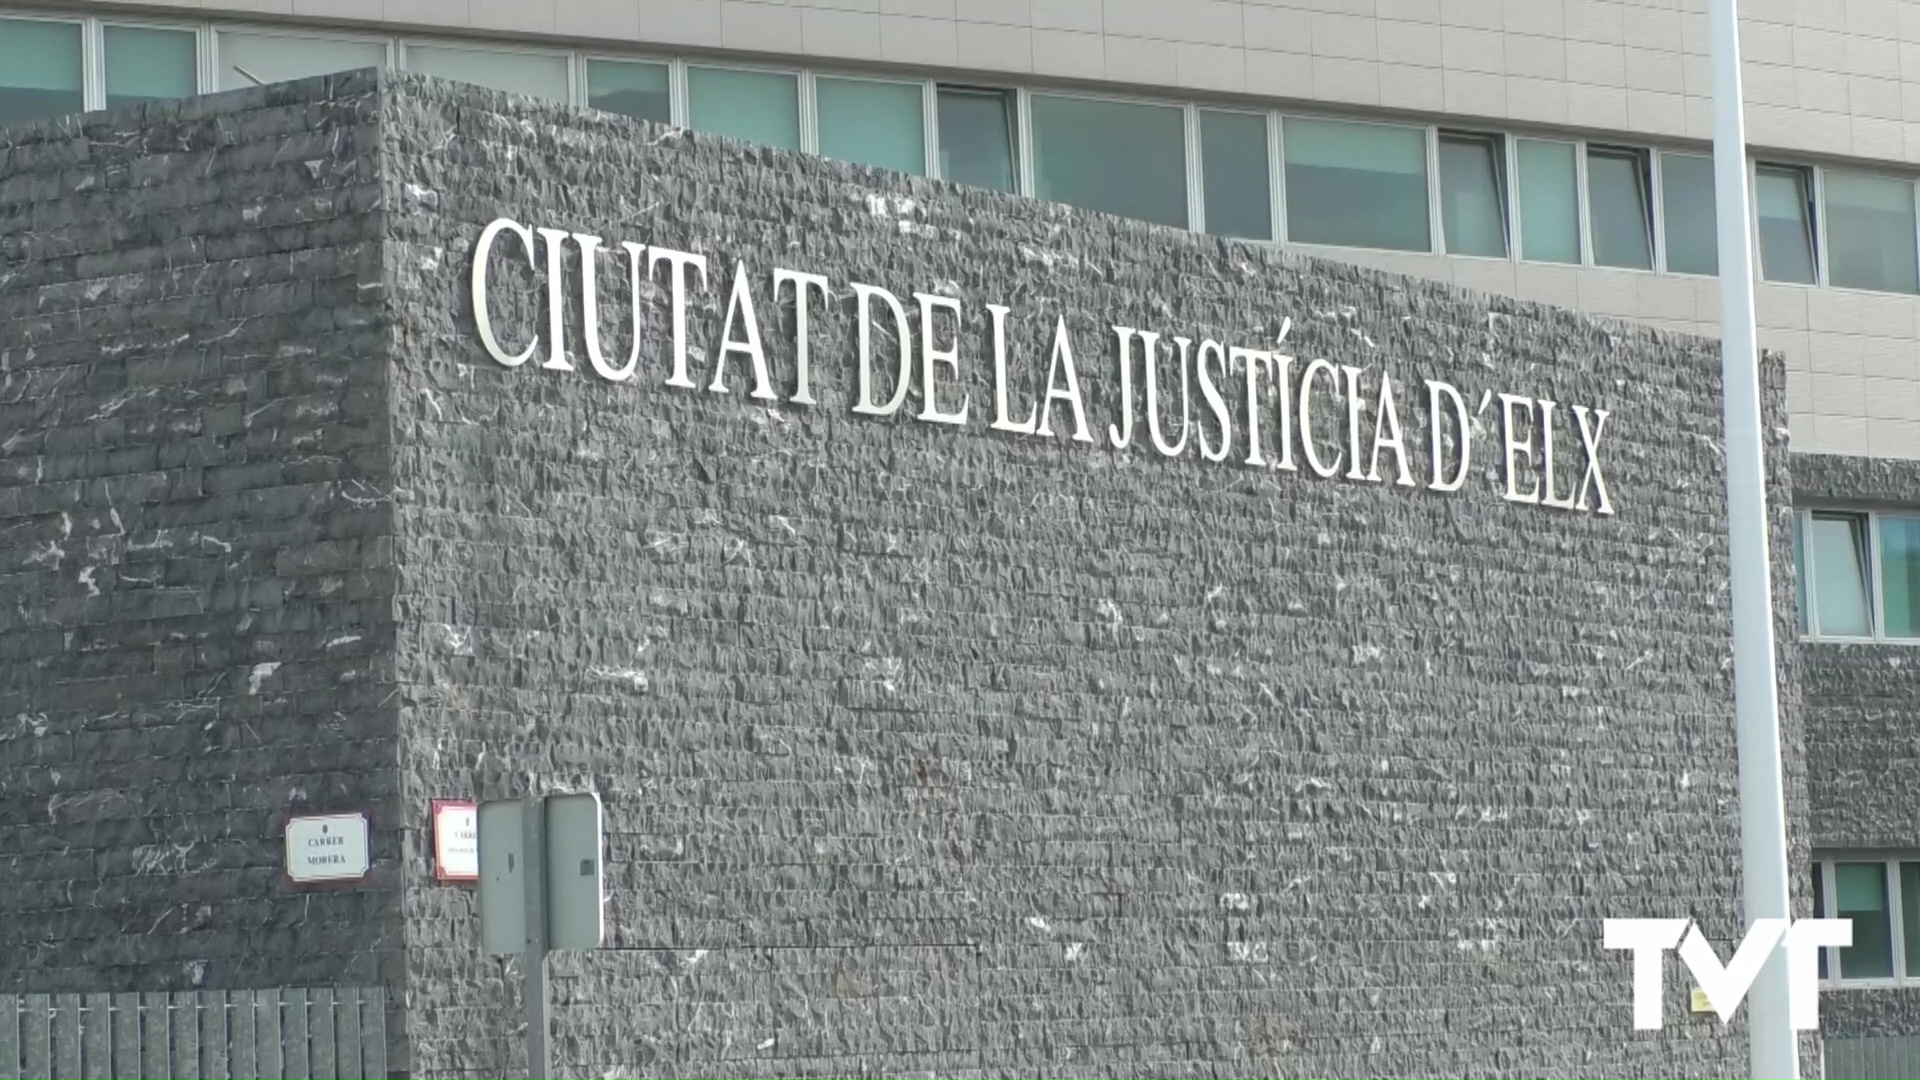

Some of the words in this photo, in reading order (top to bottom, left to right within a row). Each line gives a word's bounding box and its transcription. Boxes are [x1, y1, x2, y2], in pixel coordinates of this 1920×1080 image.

[472, 217, 828, 405] CIUTAT
[850, 281, 969, 425] DE
[986, 303, 1094, 443] LA
[1108, 316, 1416, 487] JUSTÍCIA
[308, 836, 344, 847] CARRER
[307, 854, 346, 865] MORERA
